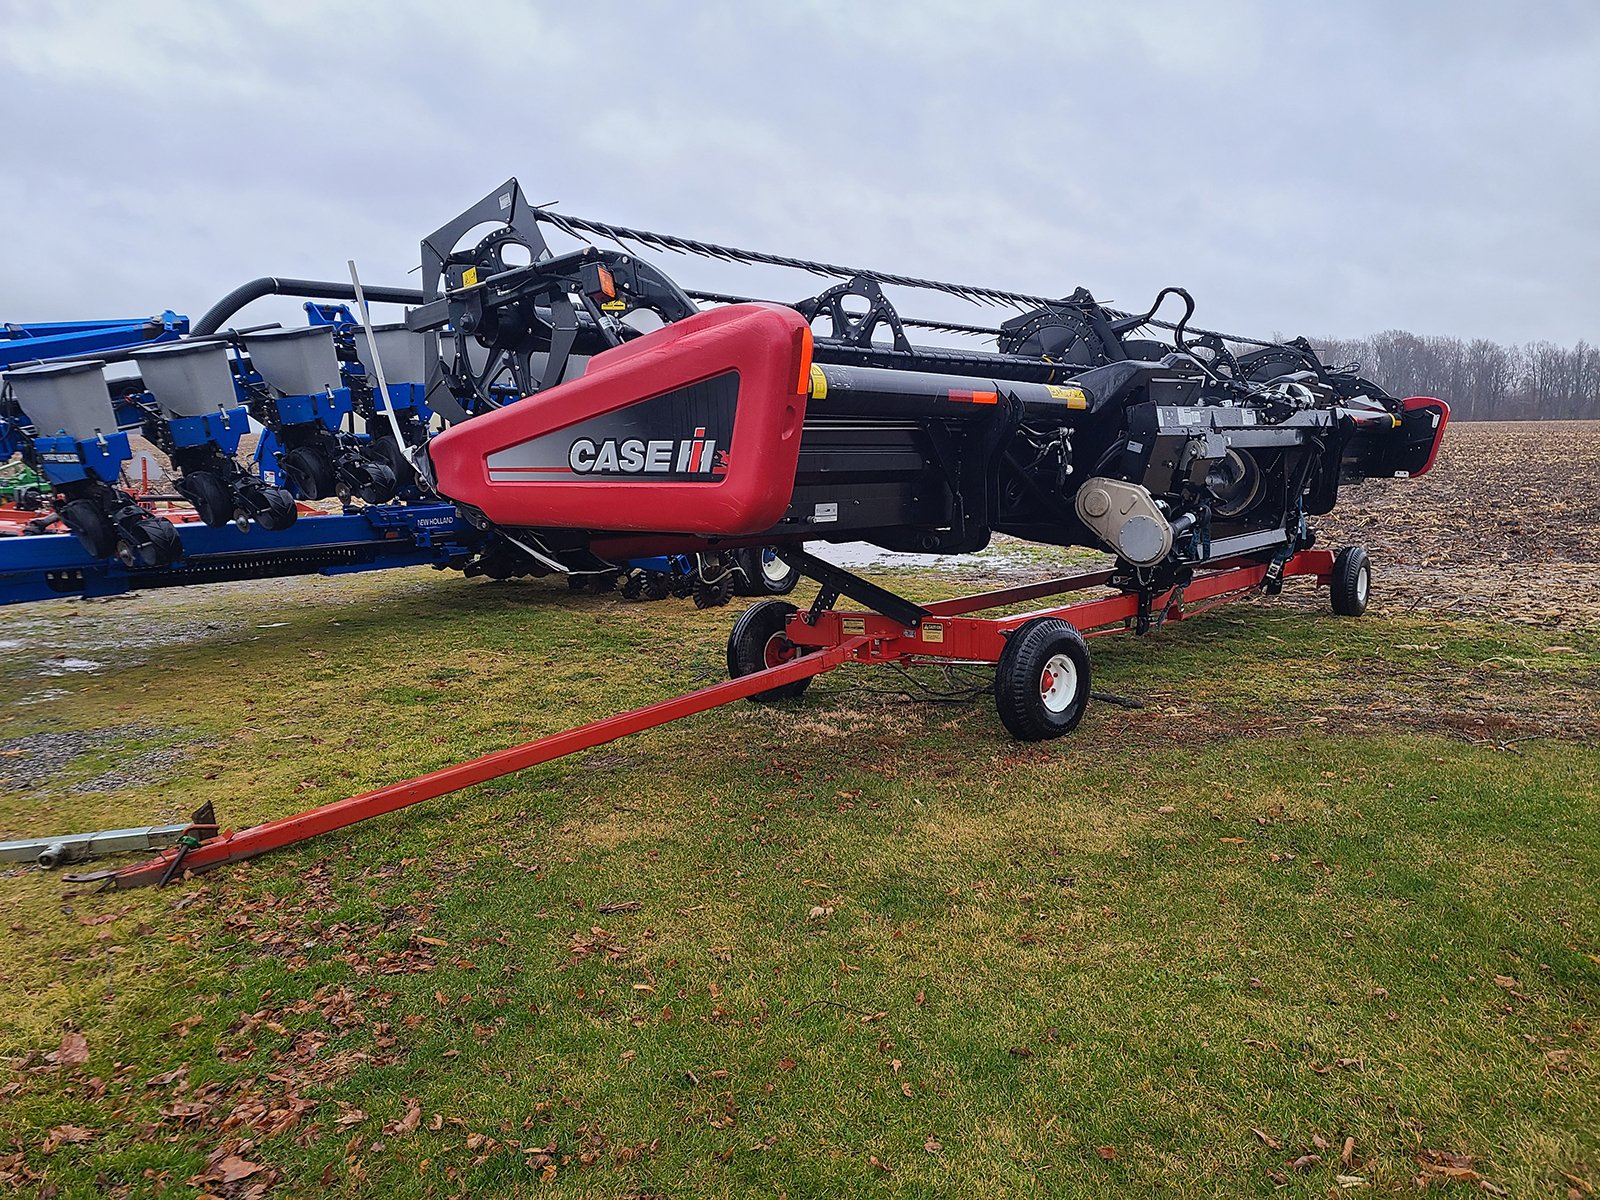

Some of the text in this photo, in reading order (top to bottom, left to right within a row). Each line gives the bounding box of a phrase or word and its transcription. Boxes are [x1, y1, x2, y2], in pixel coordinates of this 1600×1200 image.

[569, 439, 674, 474] CASE
[417, 516, 454, 527] NEW HOLLAND
